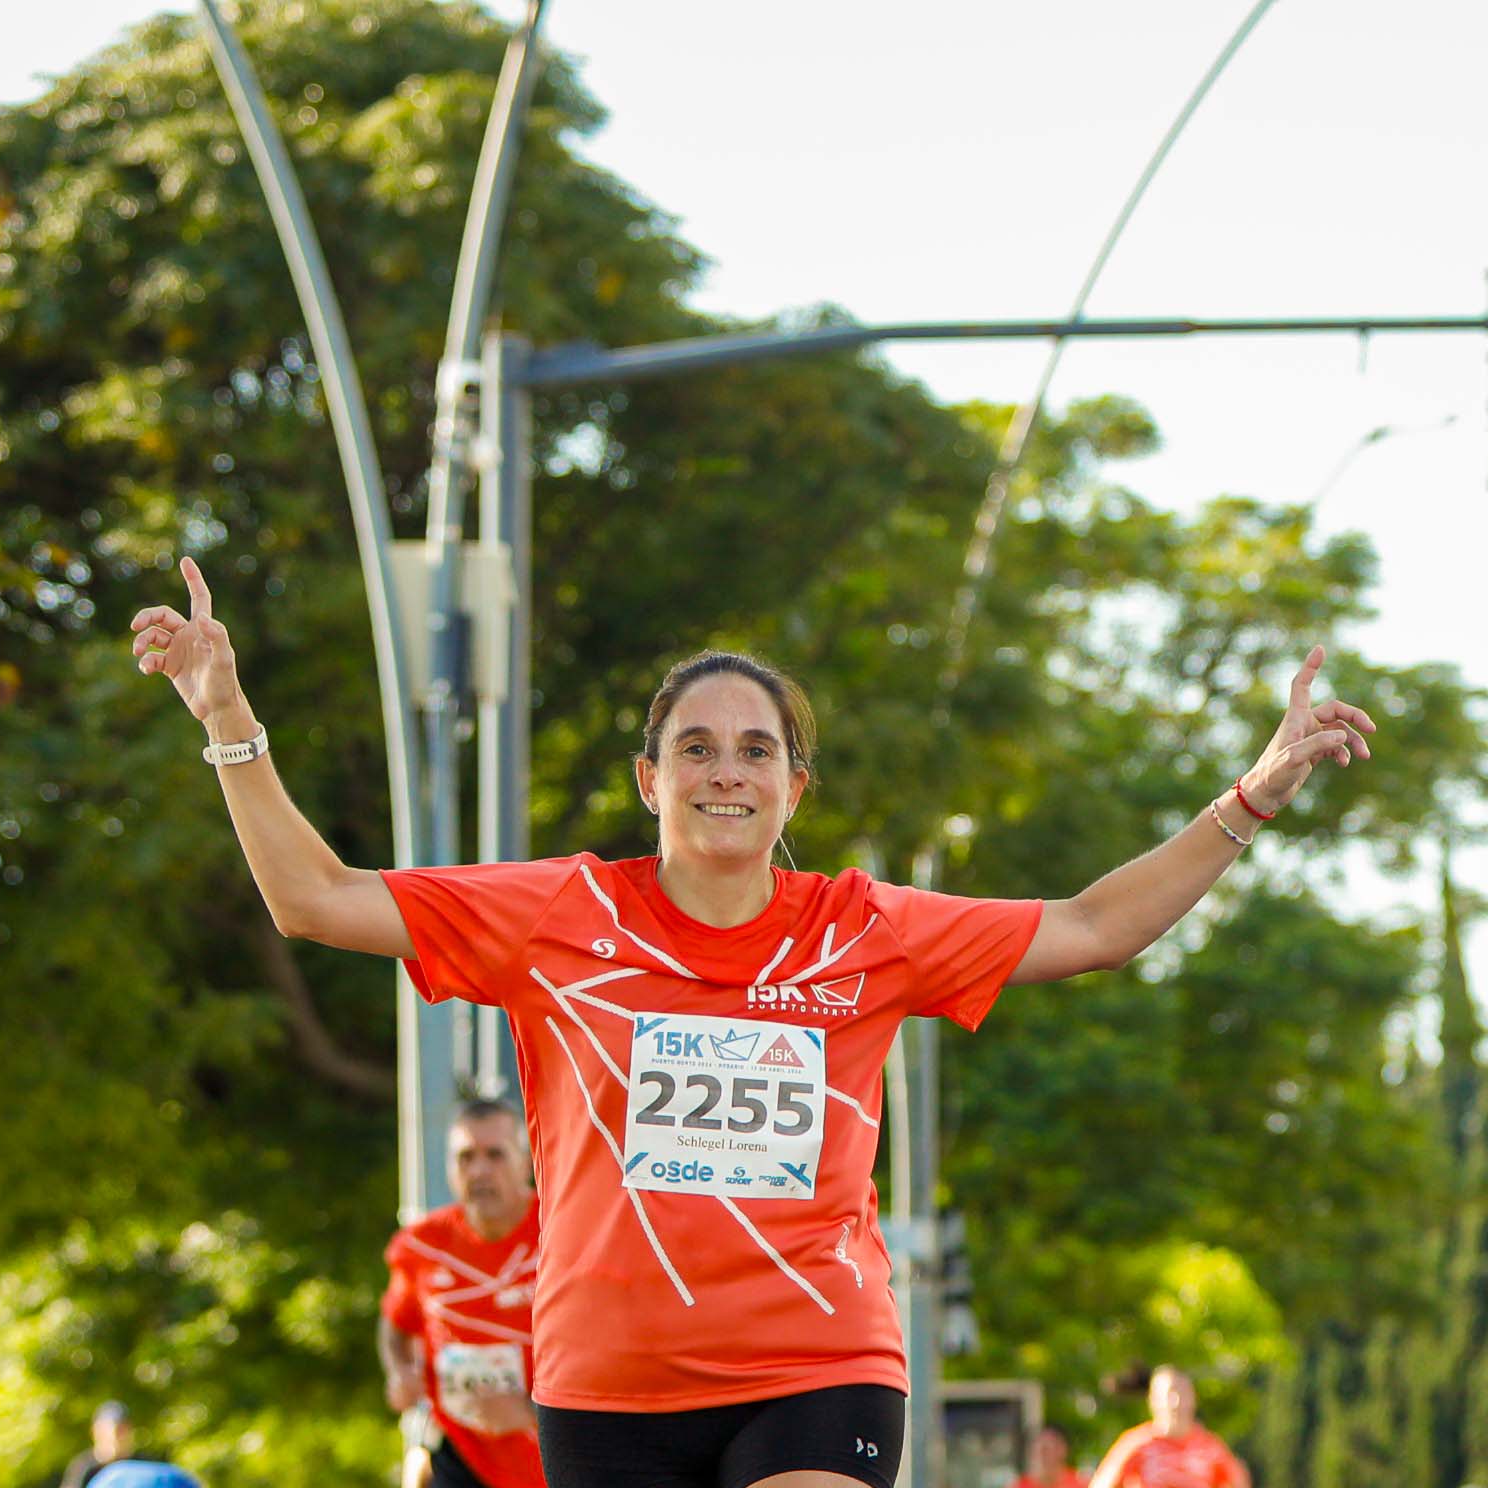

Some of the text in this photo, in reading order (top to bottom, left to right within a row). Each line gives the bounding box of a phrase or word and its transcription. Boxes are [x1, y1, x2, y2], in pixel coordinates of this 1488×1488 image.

[747, 1003, 859, 1016] PUERTO NORTE
[653, 1031, 704, 1058] 15K
[768, 1048, 794, 1063] 15K
[635, 1071, 815, 1137] 2255
[676, 1135, 768, 1153] Schlegel Lorena
[650, 1160, 714, 1183] osde
